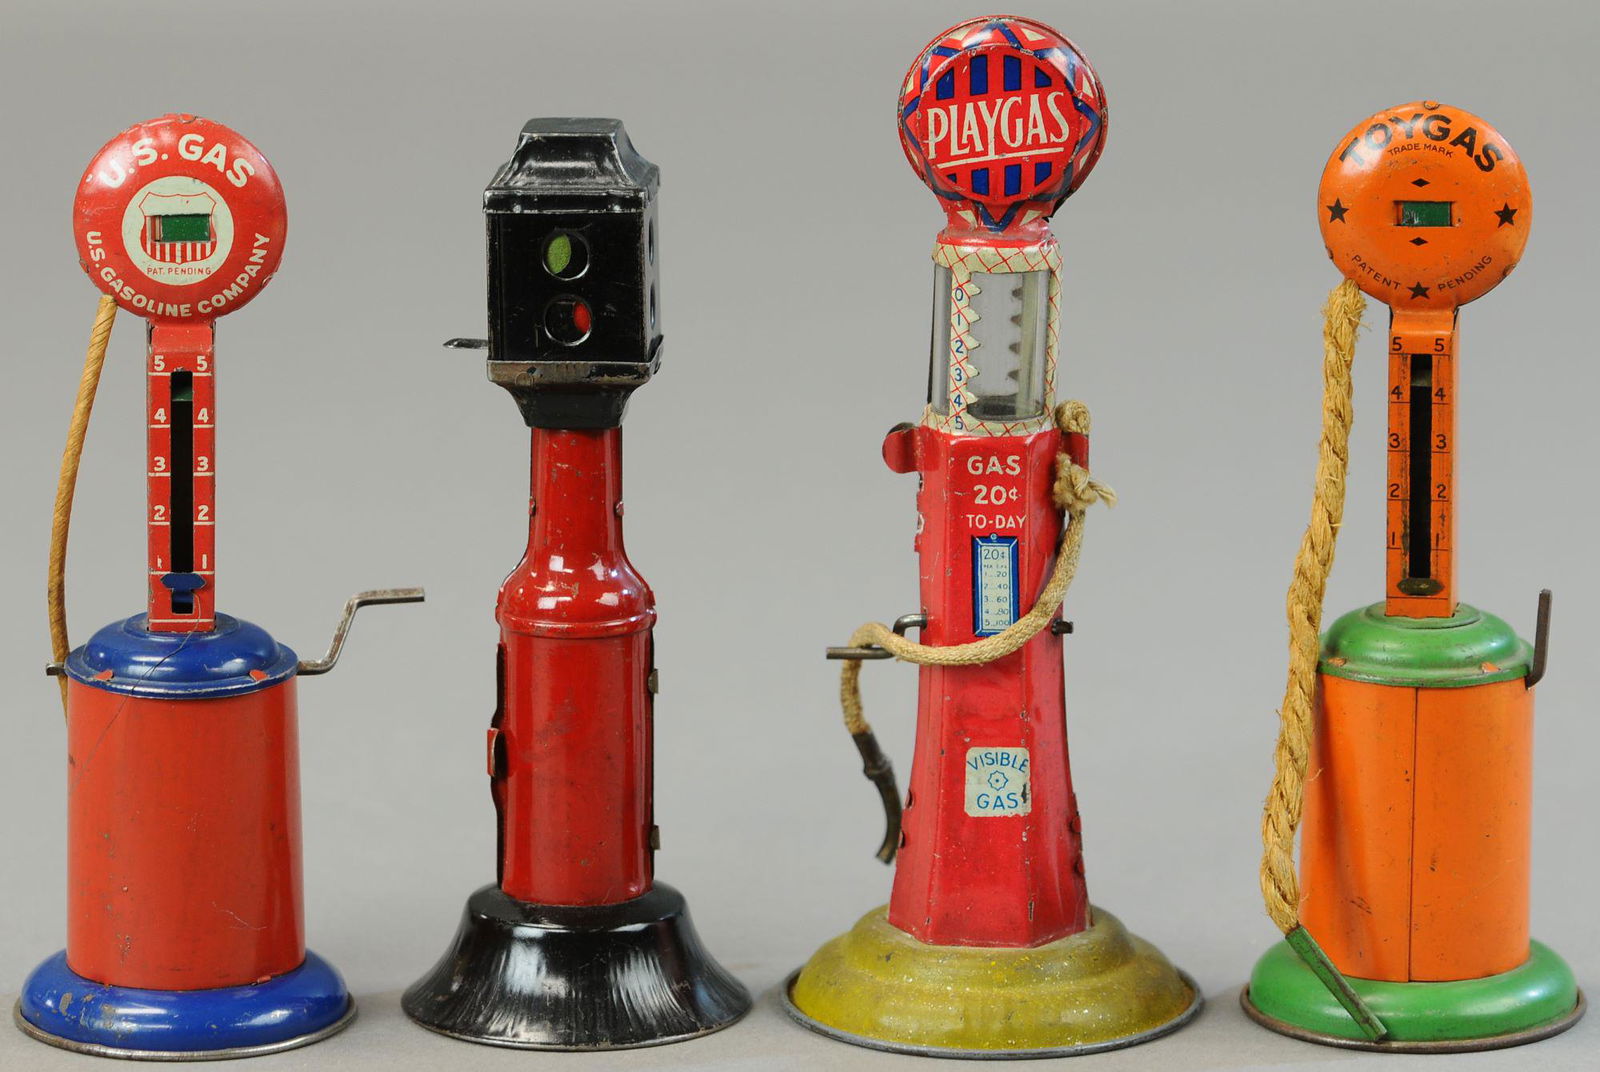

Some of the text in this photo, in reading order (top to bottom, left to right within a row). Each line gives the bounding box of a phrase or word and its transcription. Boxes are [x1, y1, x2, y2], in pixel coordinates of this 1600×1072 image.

[922, 91, 1070, 159] PLAYGAS
[1339, 113, 1504, 173] TOYGAS
[1387, 143, 1454, 159] TRADE MARK
[99, 133, 255, 189] U.S. GAS
[100, 265, 193, 318] GASOLINE
[197, 232, 271, 315] COMPANY
[146, 266, 212, 276] PAT. PENDING
[1351, 254, 1493, 292] PATENT PENDING
[954, 289, 964, 302] 0
[954, 339, 964, 354] 2
[1391, 336, 1445, 352] 5 5
[153, 354, 208, 372] 5 5
[954, 367, 963, 382] 3
[953, 394, 963, 408] 4
[1391, 385, 1446, 401] 4 4
[153, 407, 209, 424] 4 4
[954, 415, 964, 430] 5
[1389, 432, 1447, 450] 3 3
[153, 456, 209, 472] 3 3
[966, 455, 1021, 476] GAS
[973, 484, 1019, 506] 20¢
[1389, 483, 1447, 499] 2 2
[153, 504, 209, 521] 2 2
[965, 514, 1027, 529] TO-DAY
[201, 553, 208, 570] 1
[966, 751, 1029, 774] VISIBLE
[976, 791, 1019, 811] GAS
